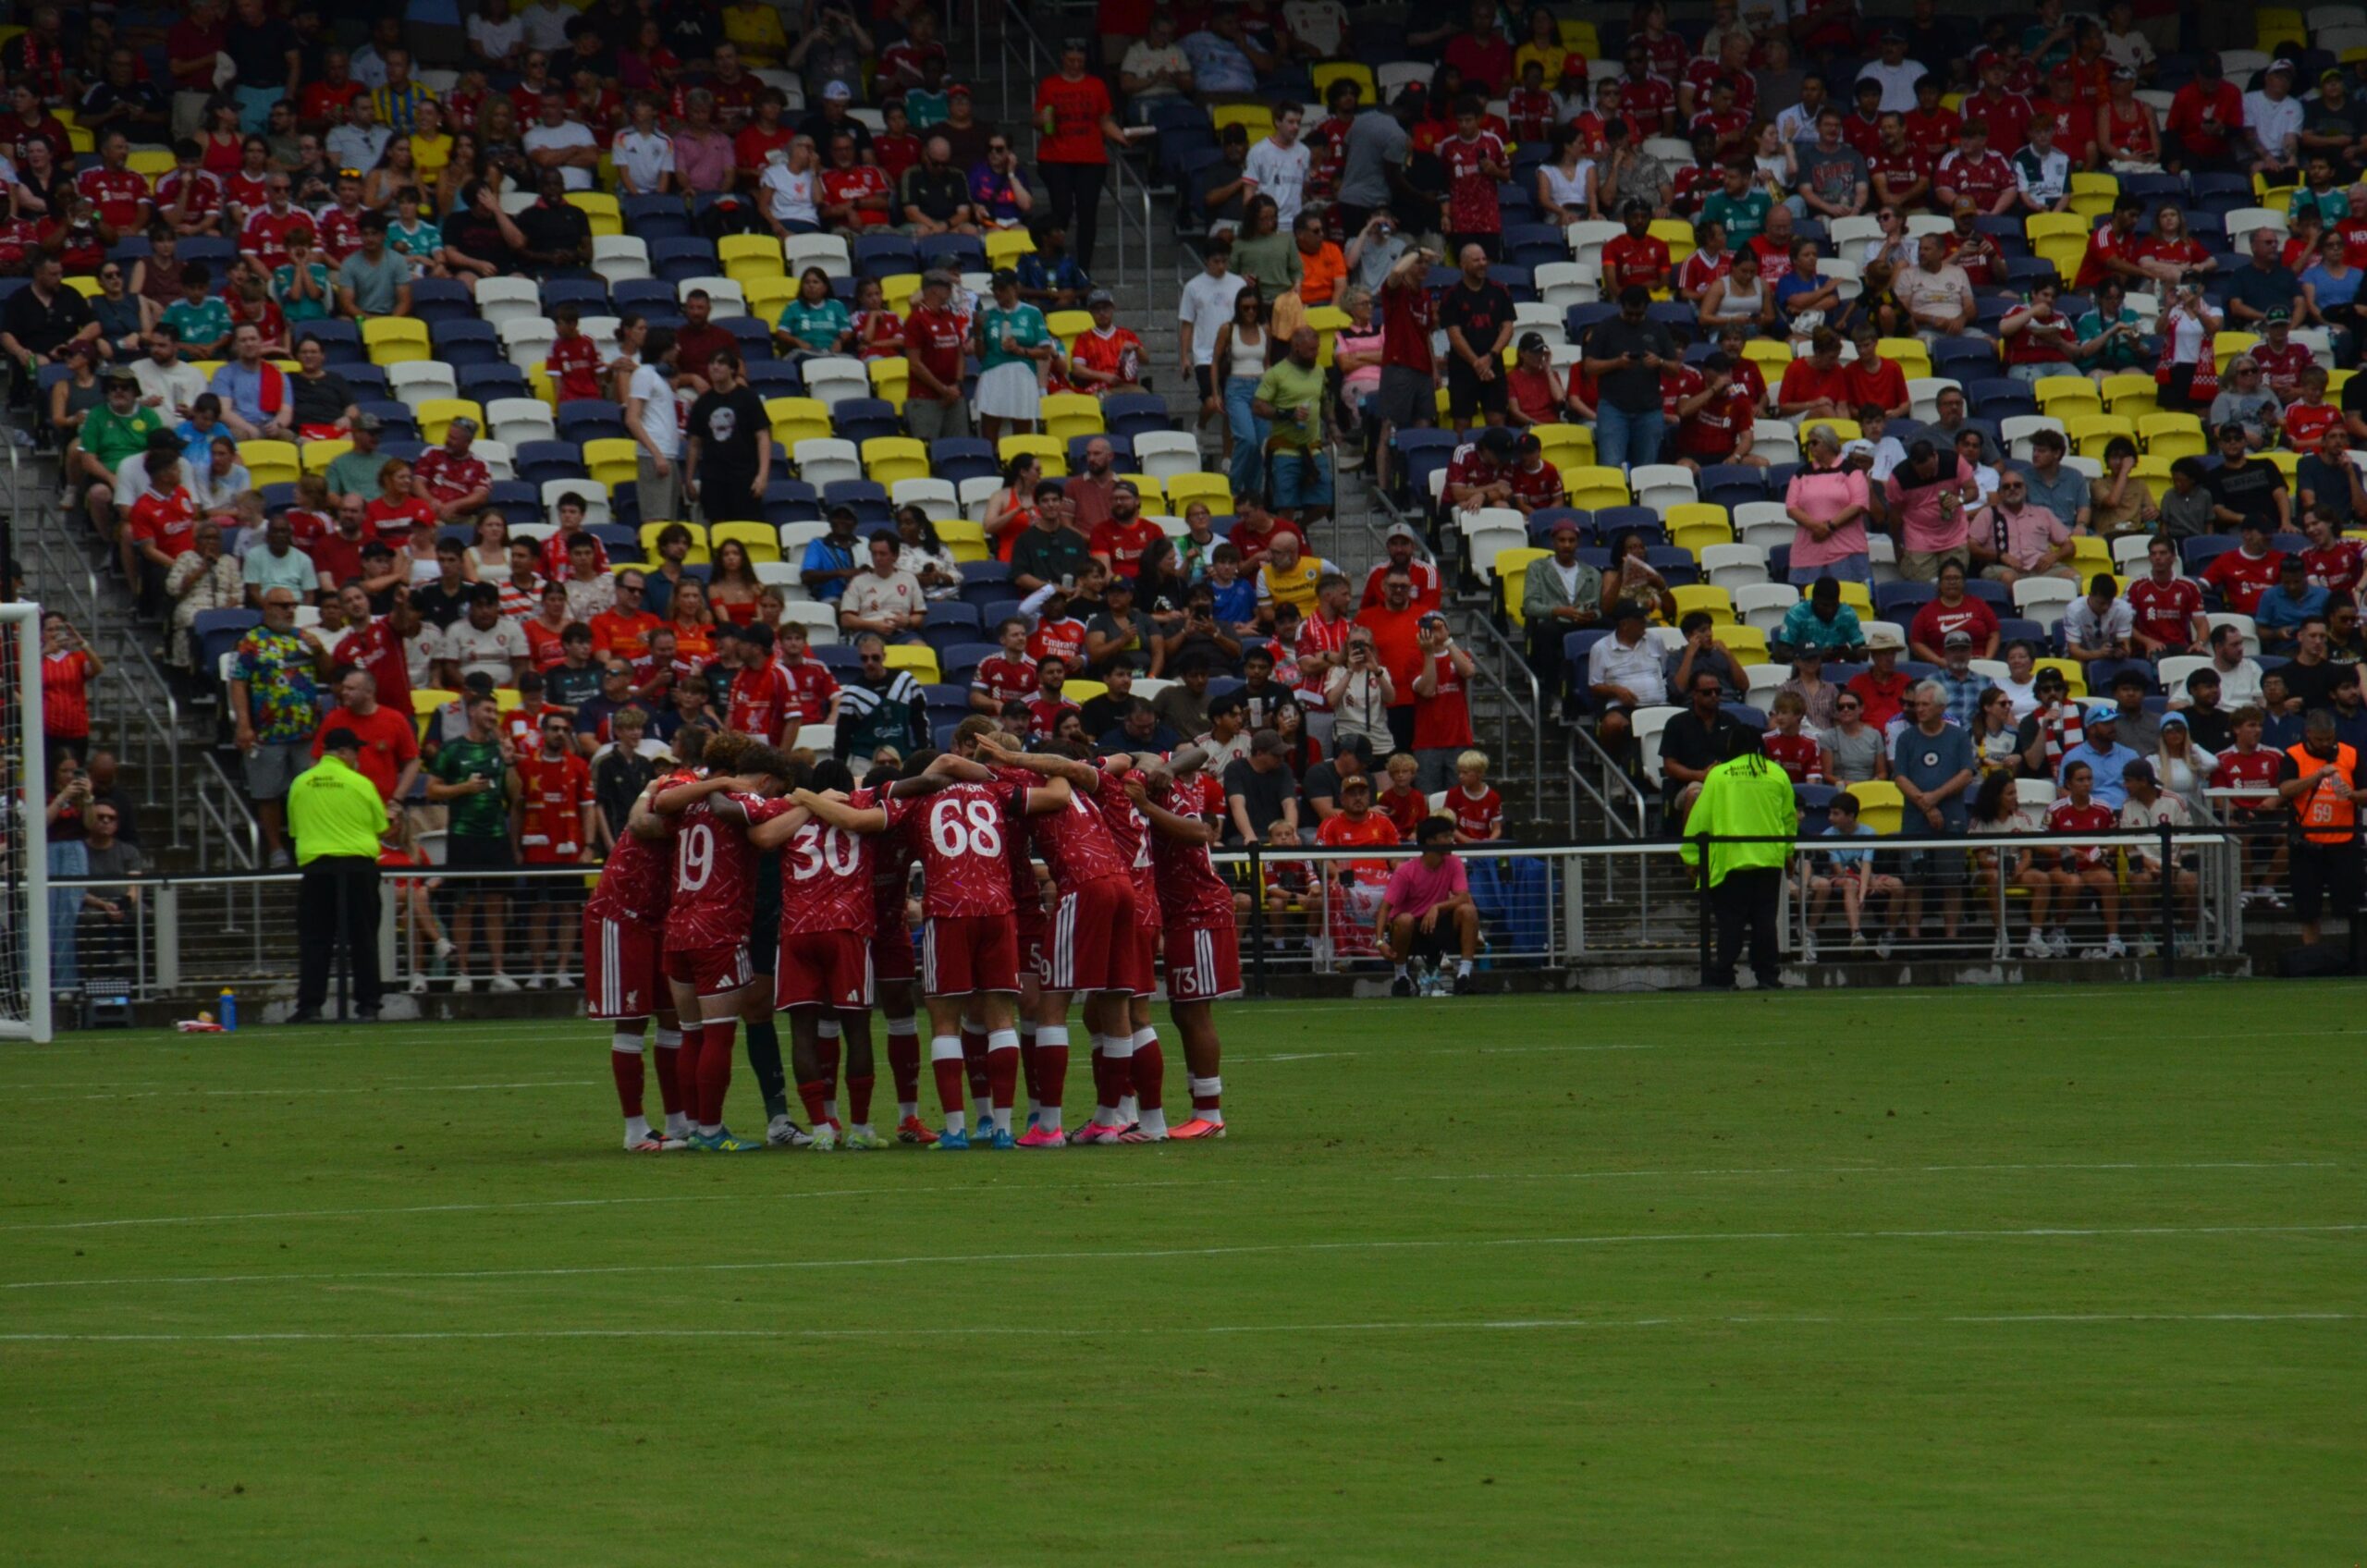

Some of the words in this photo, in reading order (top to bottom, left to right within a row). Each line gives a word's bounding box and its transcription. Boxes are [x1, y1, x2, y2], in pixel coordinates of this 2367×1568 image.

[930, 798, 1001, 858] 68
[2313, 802, 2333, 823] 59
[677, 824, 714, 893] 19
[792, 823, 861, 880] 30
[1172, 966, 1197, 994] 73
